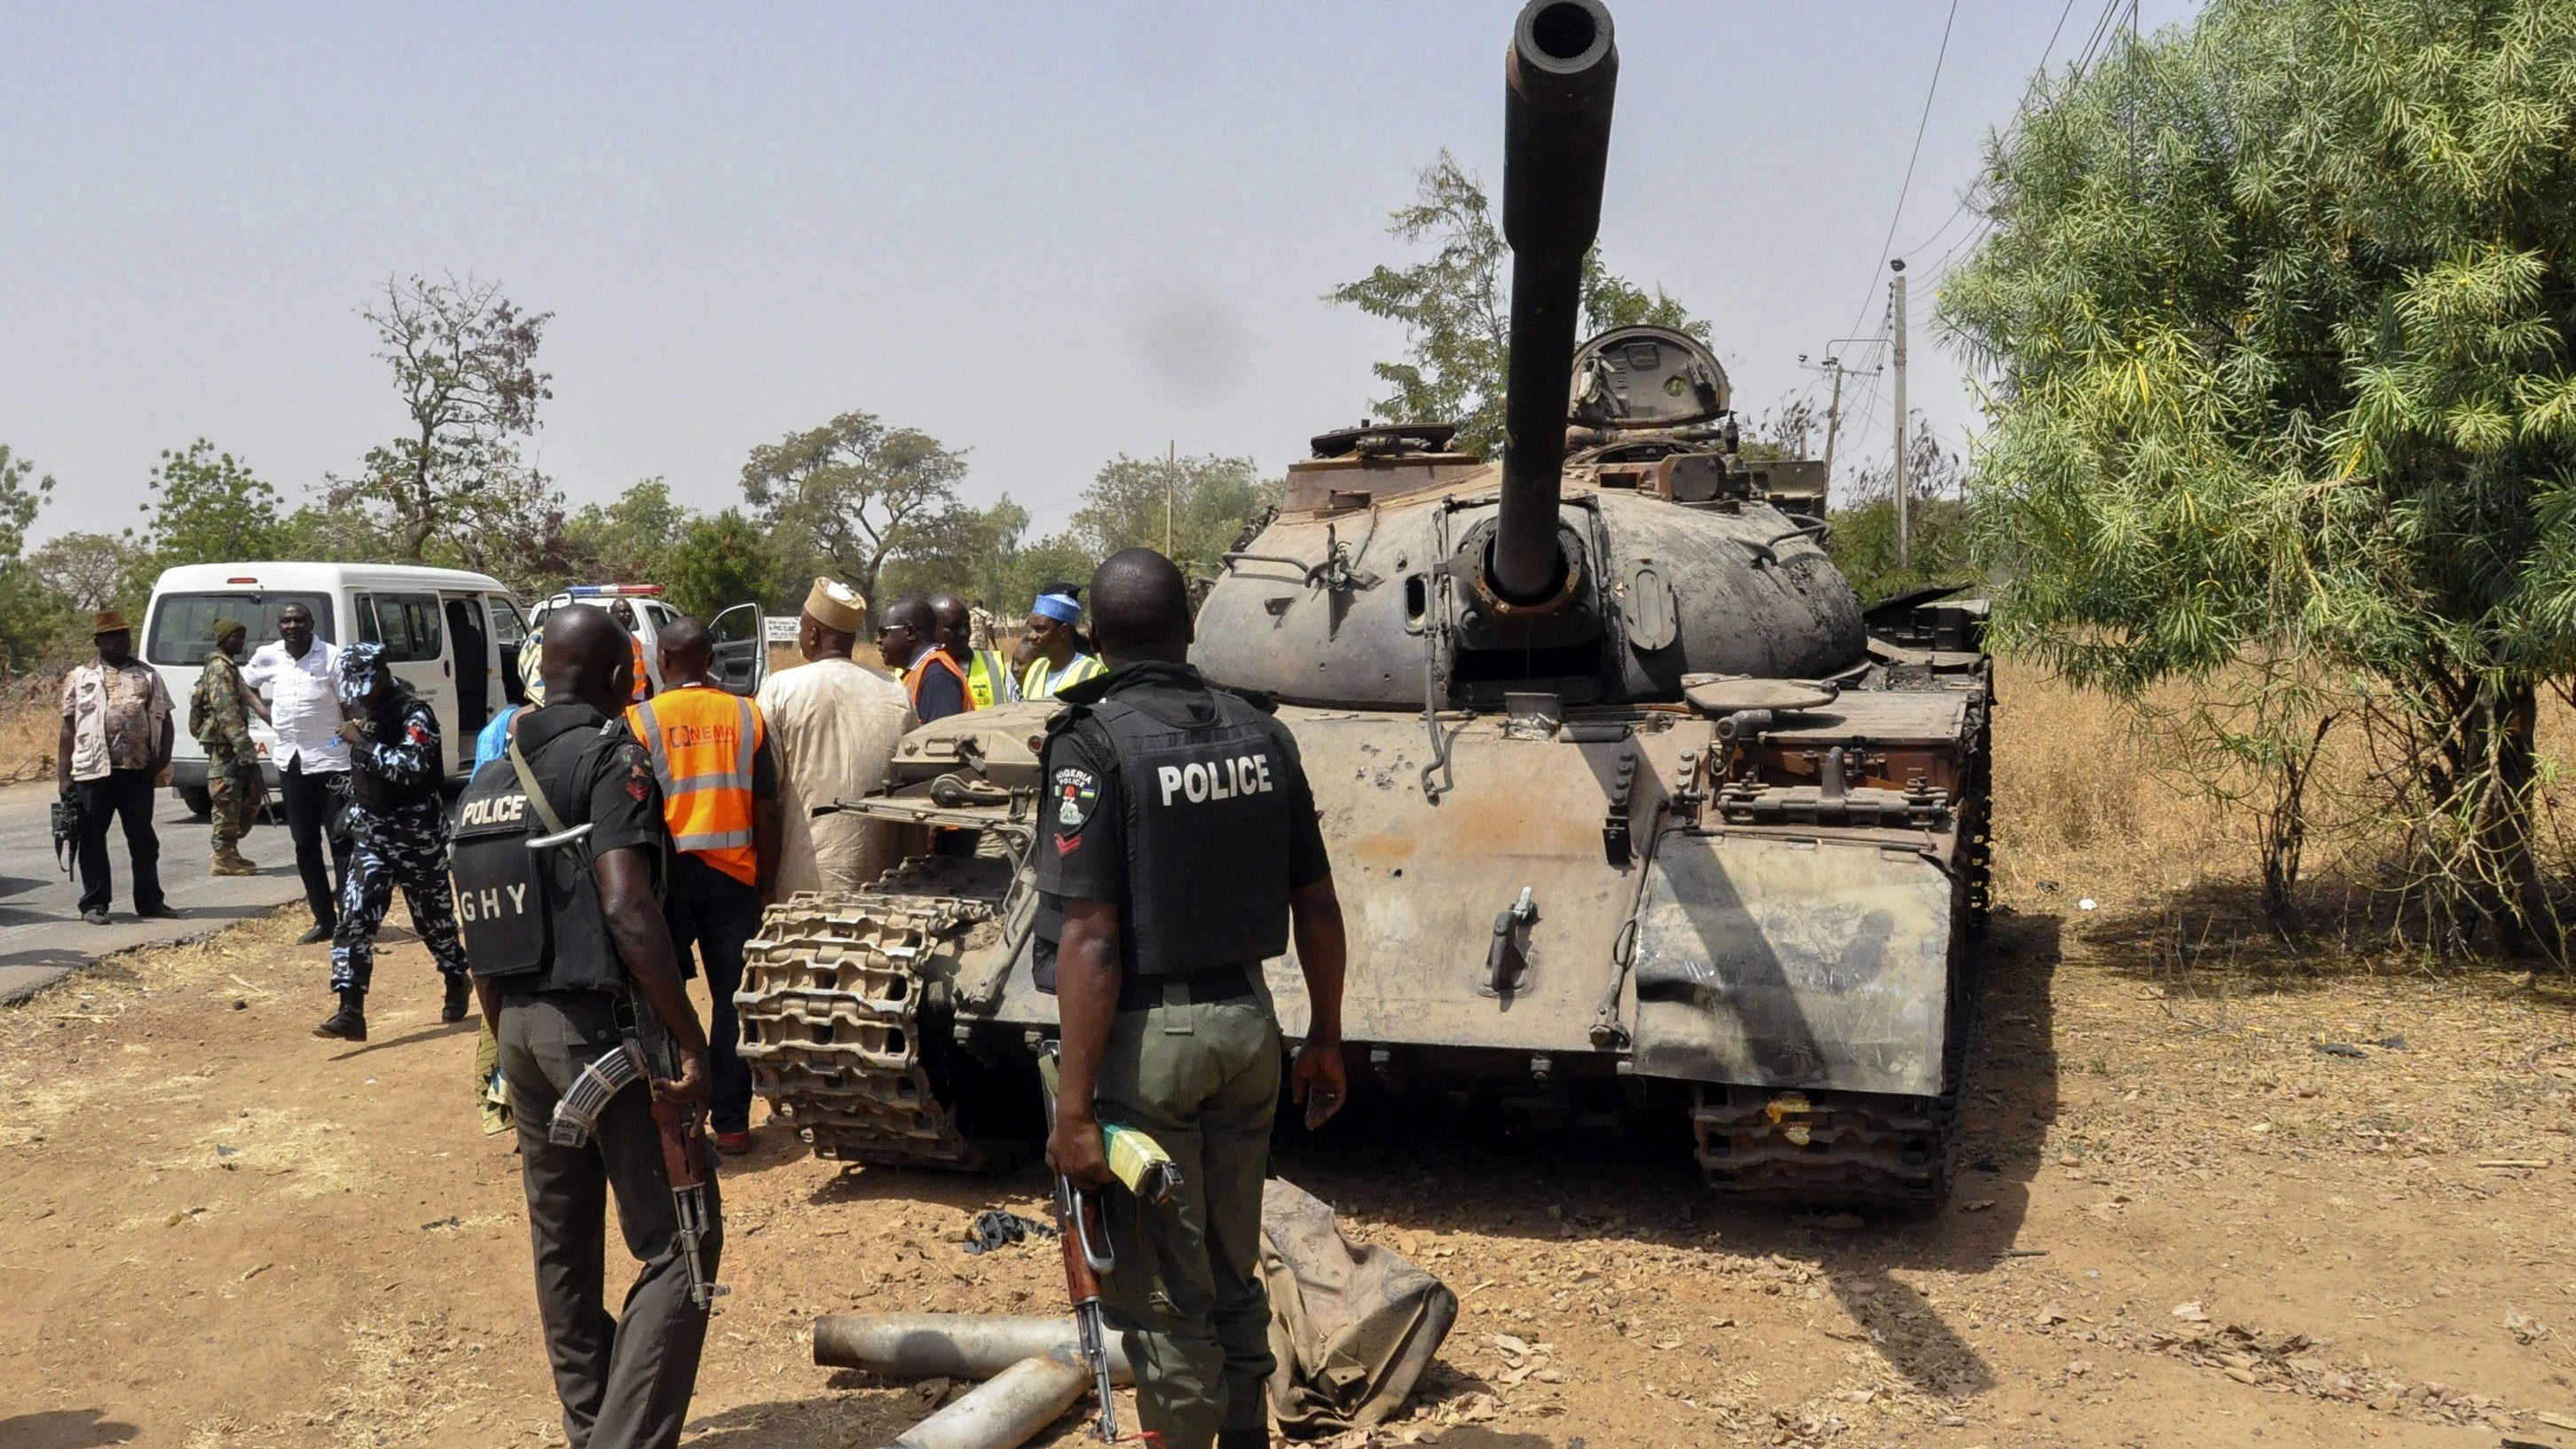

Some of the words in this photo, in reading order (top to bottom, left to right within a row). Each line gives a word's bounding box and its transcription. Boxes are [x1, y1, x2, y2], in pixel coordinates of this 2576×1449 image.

[689, 725, 736, 741] NEMA
[1056, 768, 1092, 784] NIGERIA
[1059, 777, 1084, 788] POLICE
[1157, 753, 1273, 807] POLICE
[461, 795, 527, 827] POLICE
